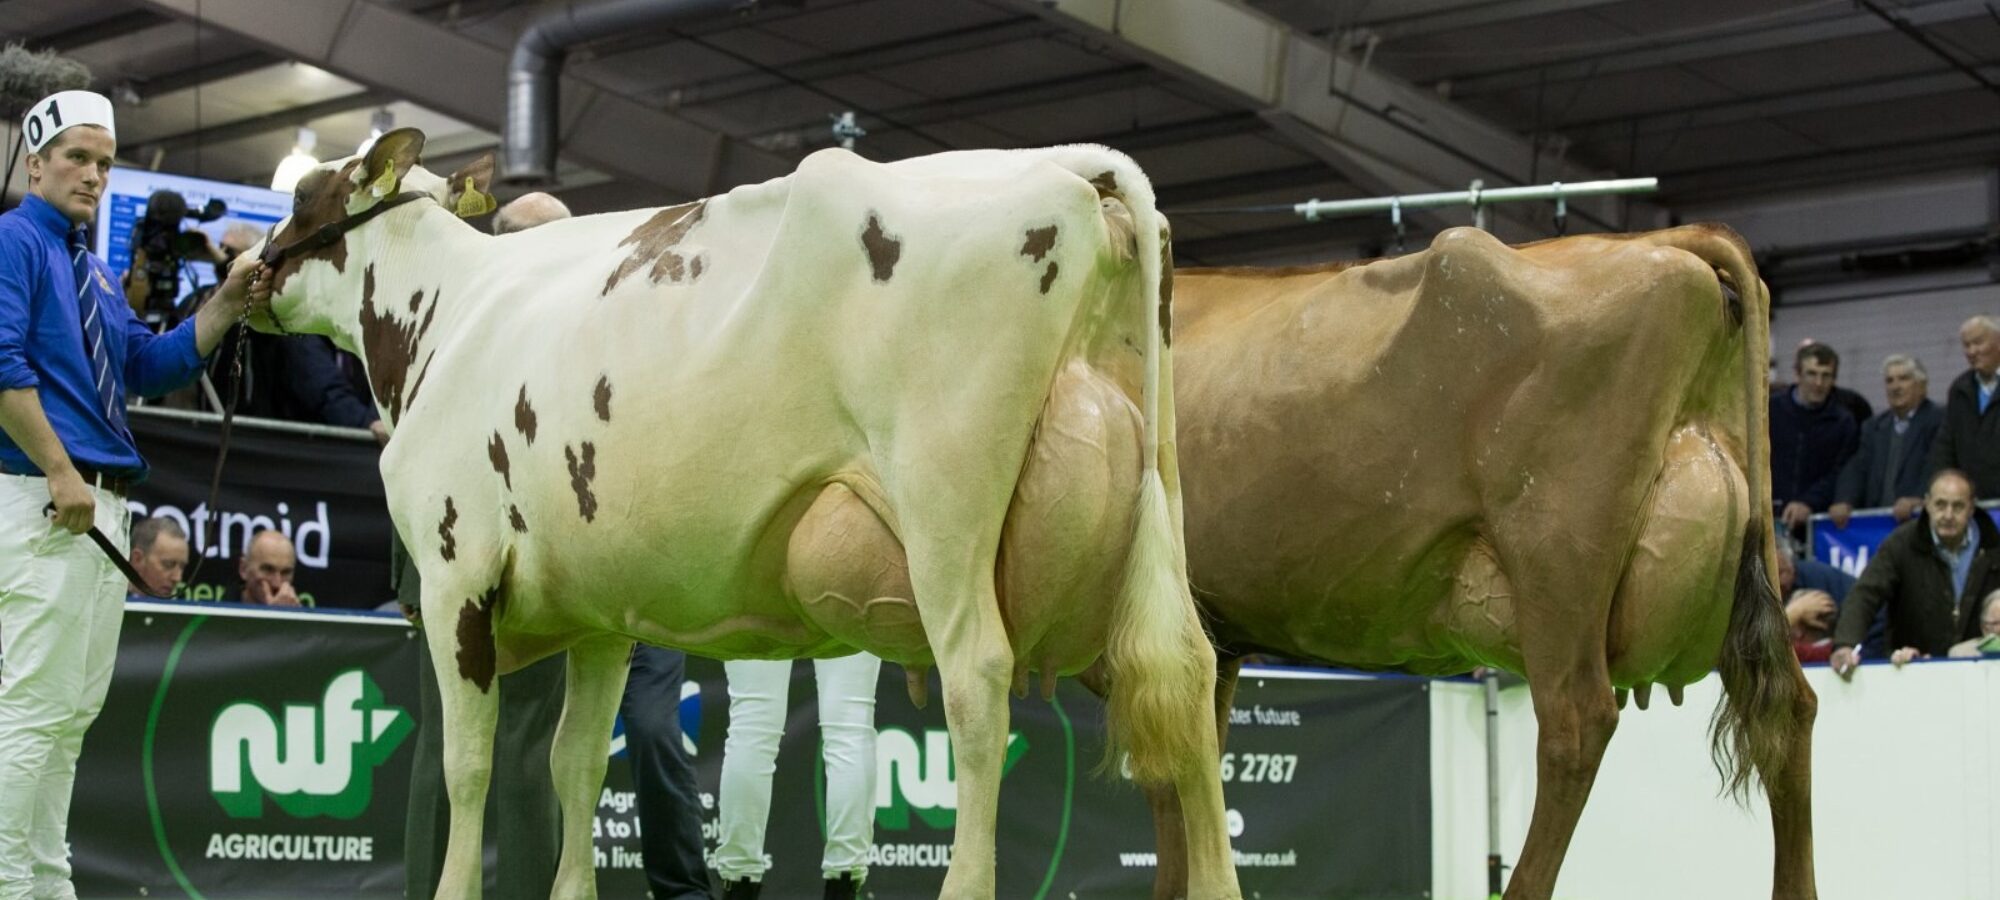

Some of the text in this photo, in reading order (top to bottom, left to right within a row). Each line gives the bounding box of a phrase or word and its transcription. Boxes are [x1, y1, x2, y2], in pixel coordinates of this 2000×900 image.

[1253, 704, 1301, 726] future
[1239, 753, 1298, 783] 2787
[605, 819, 631, 838] to
[205, 833, 373, 861] AGRICULTURE
[867, 843, 954, 867] AGRICUL
